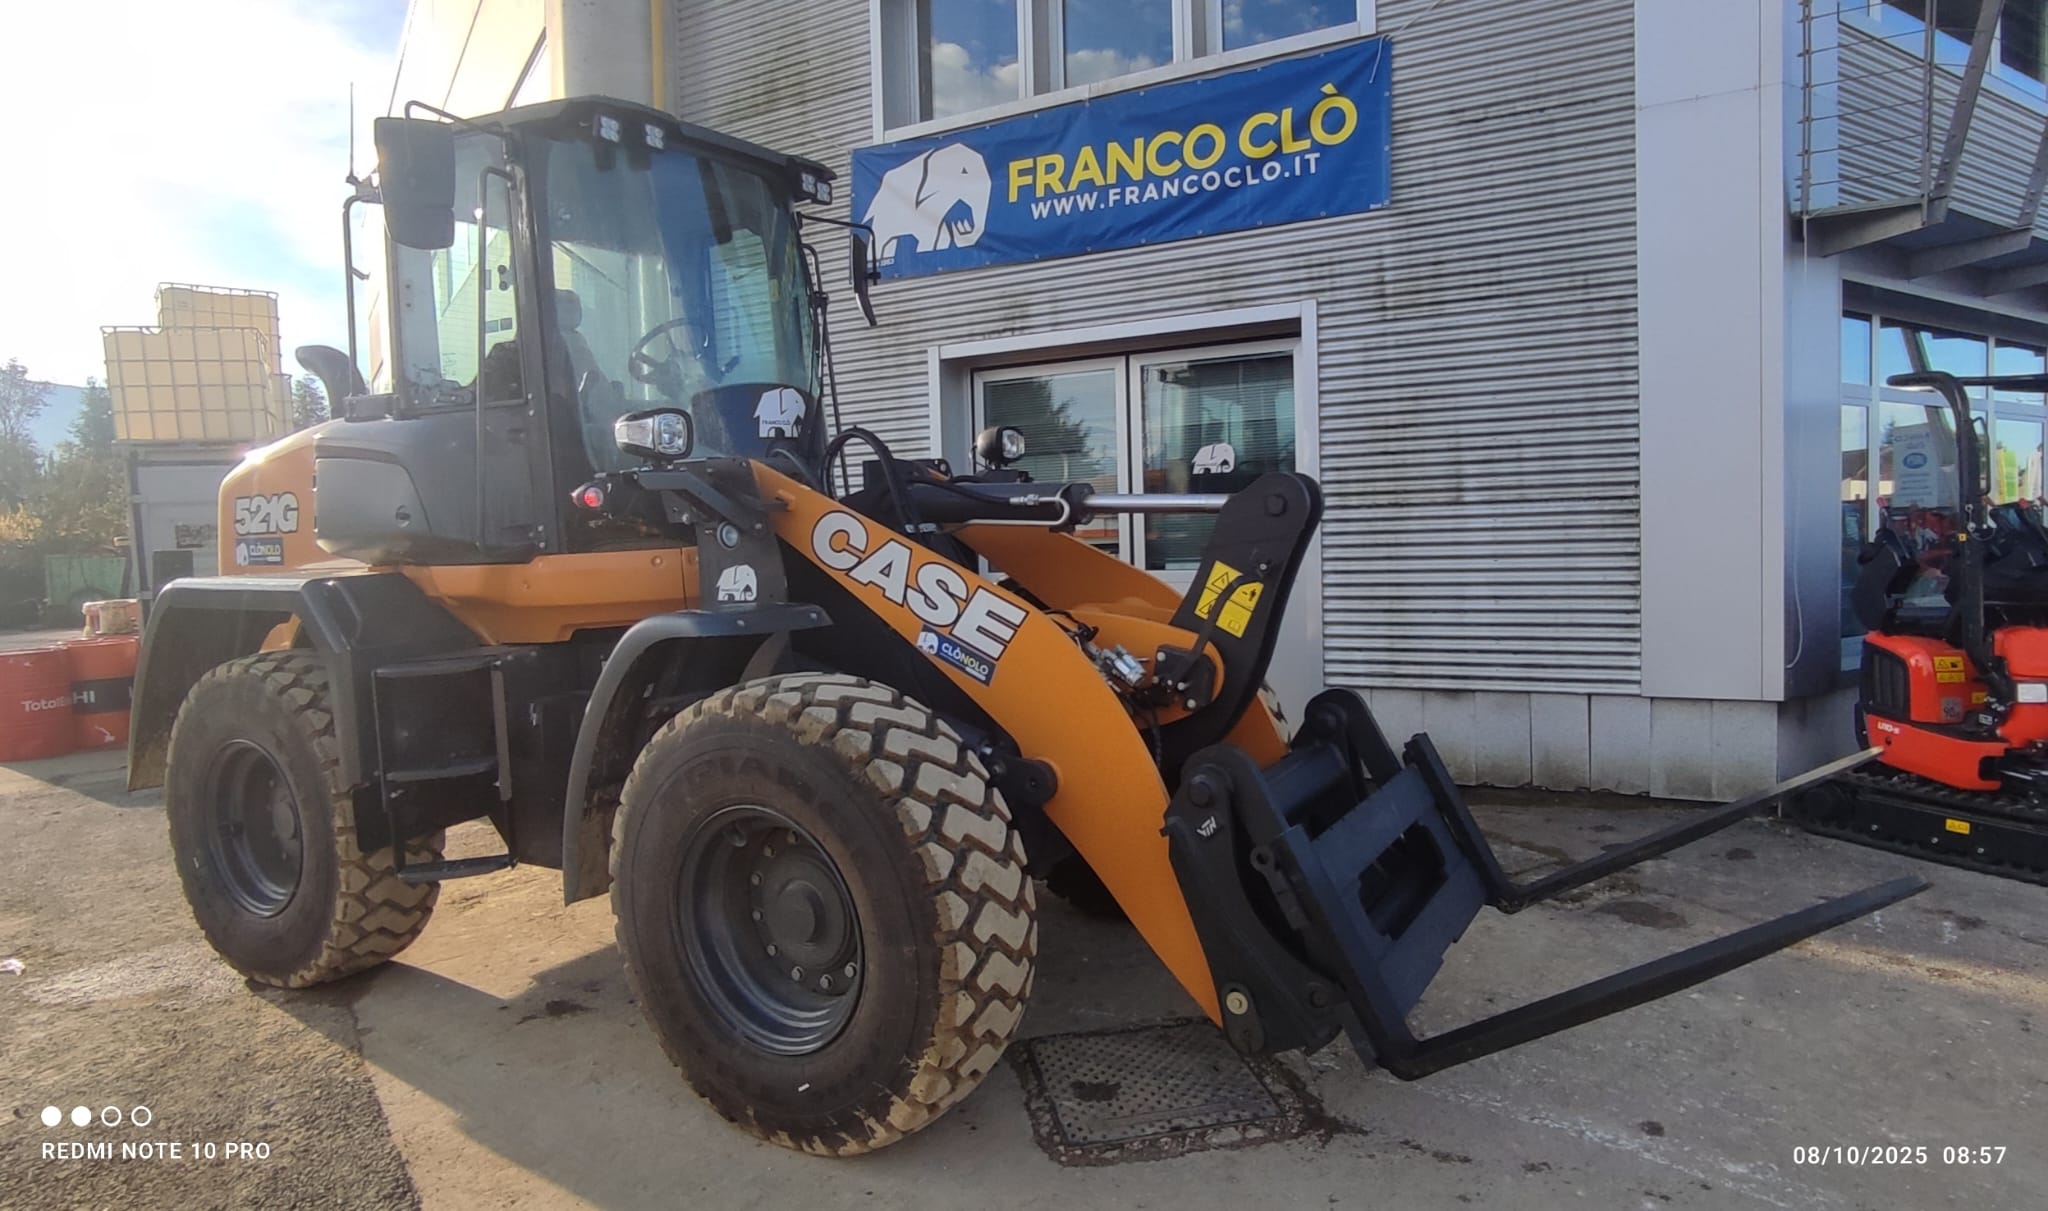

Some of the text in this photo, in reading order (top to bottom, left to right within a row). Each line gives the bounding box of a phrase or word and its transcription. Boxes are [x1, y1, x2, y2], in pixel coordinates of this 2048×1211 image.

[1008, 82, 1358, 203] FRANCO CLÒ
[1031, 152, 1321, 220] WWW.FRANCOCLO.IT
[234, 491, 299, 536] 521G
[811, 510, 1030, 662] CASE
